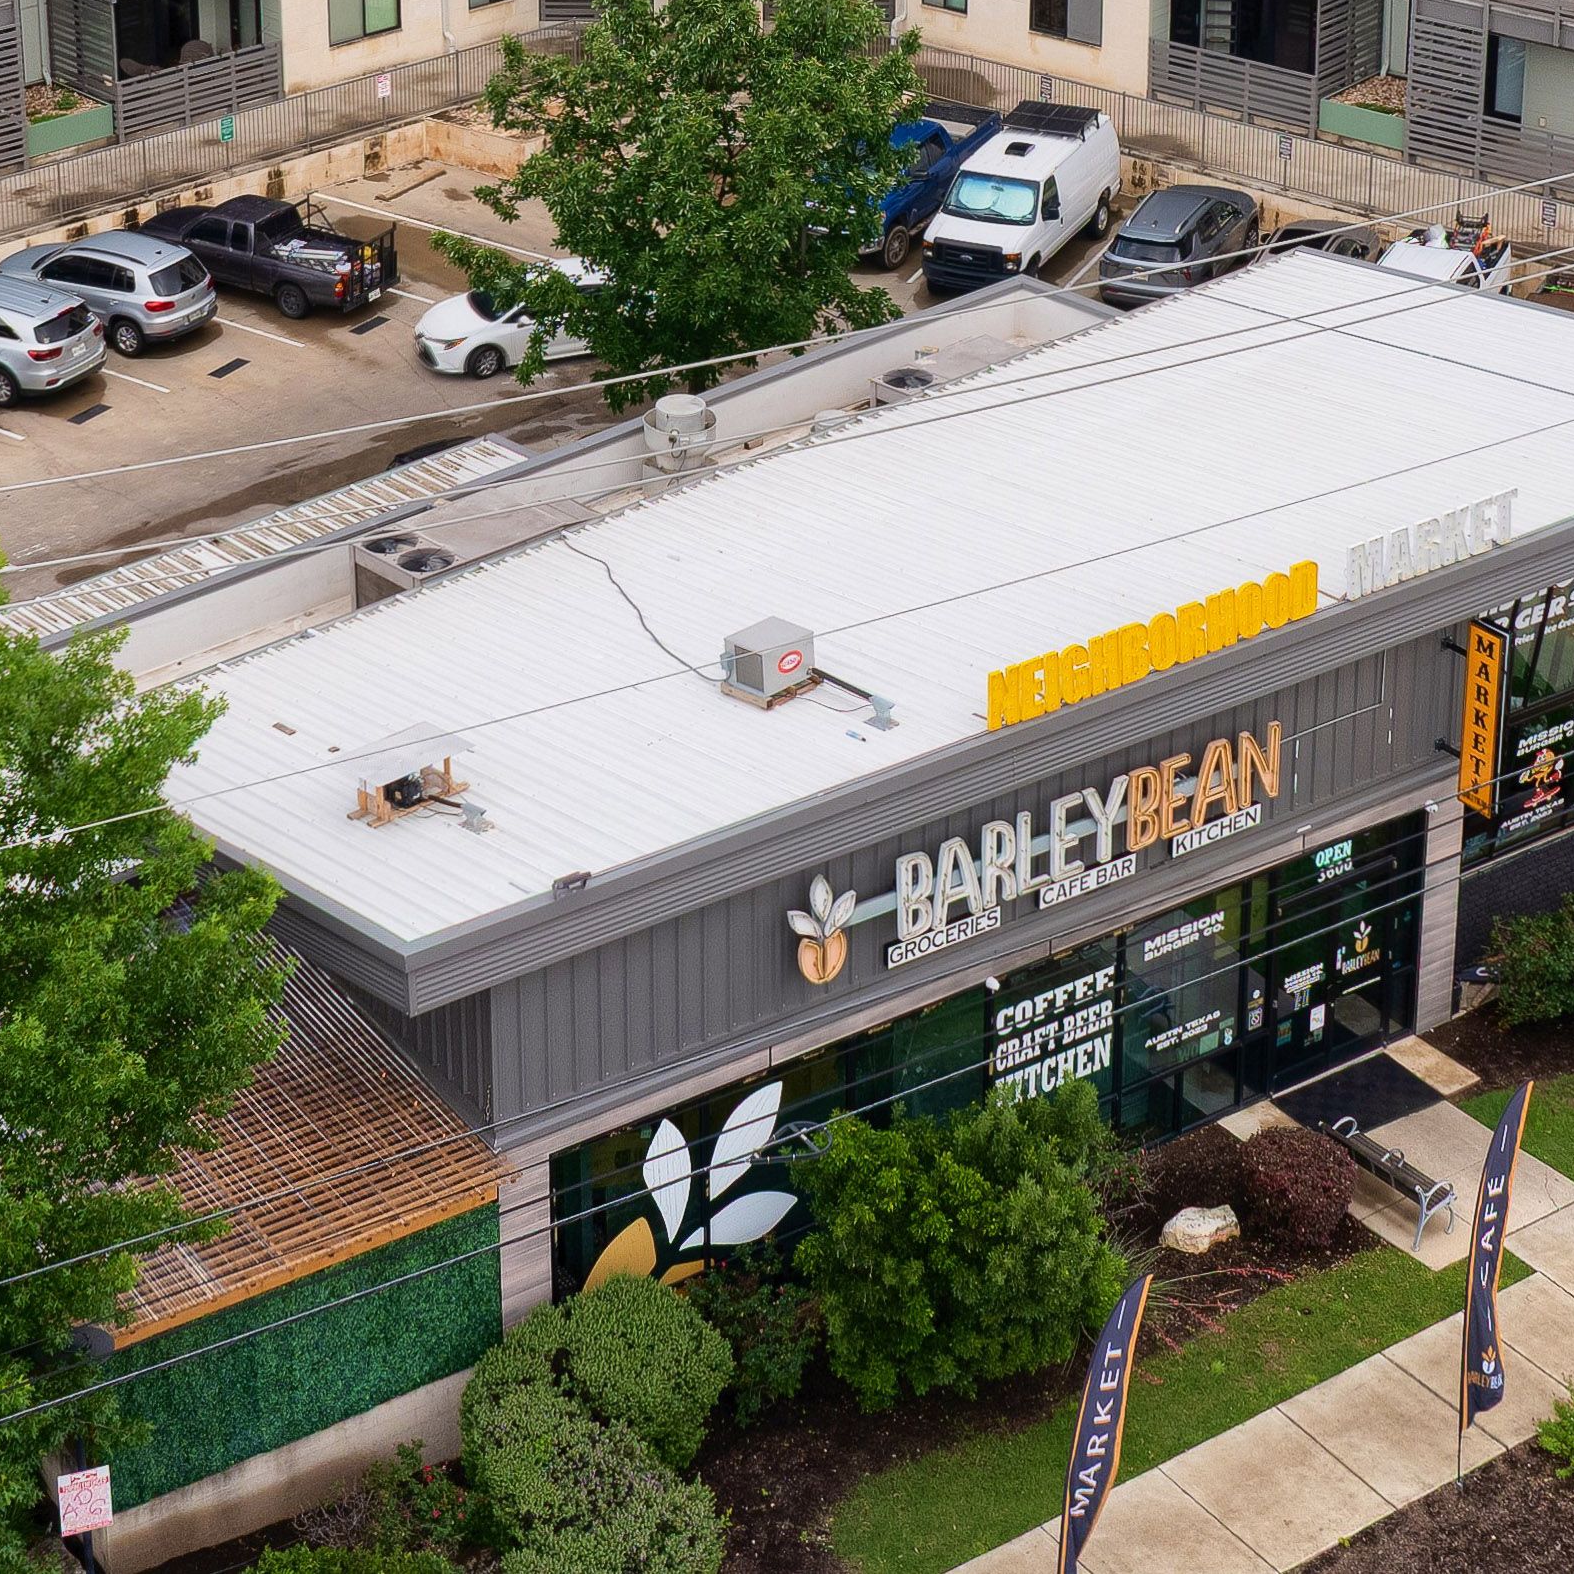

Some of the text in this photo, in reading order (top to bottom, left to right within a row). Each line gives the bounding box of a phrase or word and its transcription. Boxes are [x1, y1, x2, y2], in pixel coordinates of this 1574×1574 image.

[1345, 488, 1519, 600] MARKET
[987, 559, 1319, 731] NEIGHBORHOOD
[1469, 633, 1495, 777] MARKET
[1516, 730, 1564, 757] BURGER
[1174, 807, 1259, 854] KITCHEN
[1315, 839, 1352, 866] OPEN
[1041, 857, 1134, 906] CAFE BAR
[889, 910, 999, 966] GROCERIES
[1144, 911, 1225, 952] MISSION
[1144, 922, 1225, 962] BURGER CO.
[995, 965, 1116, 1036] COFFEE
[1144, 1025, 1184, 1048] AUSTIN
[1184, 1009, 1221, 1033] TEXAS
[995, 999, 1114, 1072] CRAFT BEER
[1480, 1174, 1505, 1289] CAFE
[1070, 1341, 1123, 1517] MARKET
